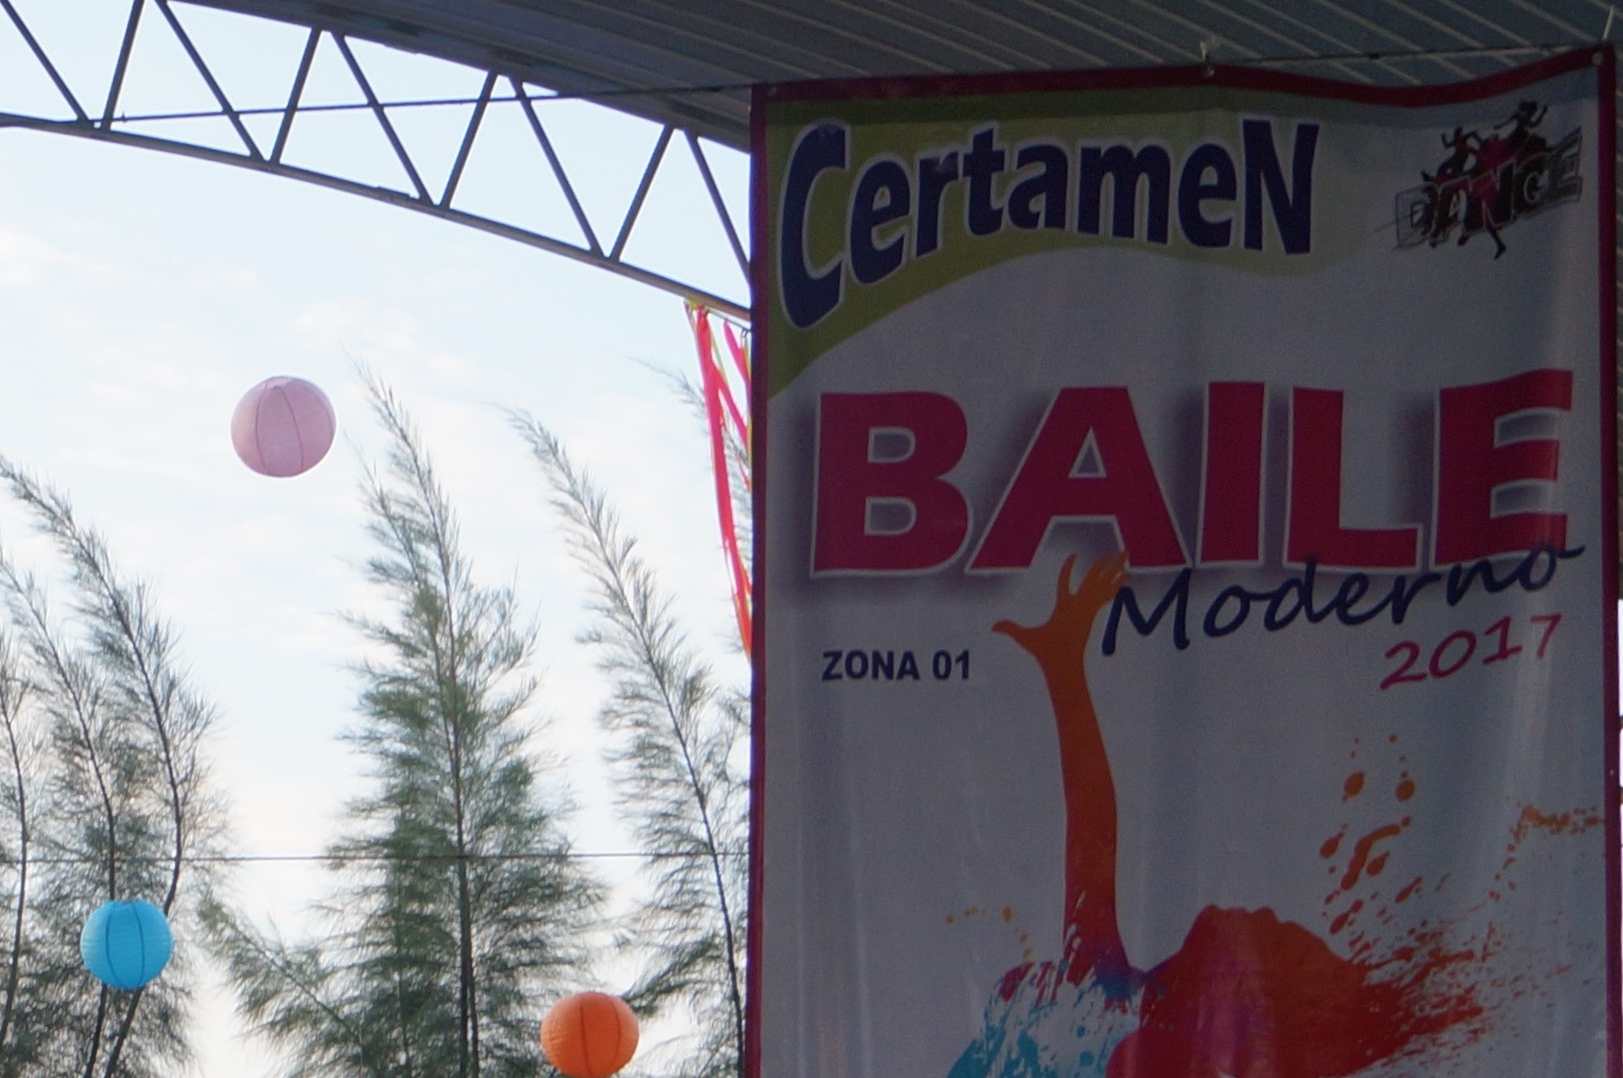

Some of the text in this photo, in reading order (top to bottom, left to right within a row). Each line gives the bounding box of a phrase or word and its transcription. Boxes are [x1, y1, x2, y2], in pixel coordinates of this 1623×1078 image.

[781, 119, 1319, 327] CertameN
[812, 369, 1574, 575] BAILE
[1102, 543, 1585, 655] Moderno
[1380, 613, 1562, 689] 2017
[821, 648, 972, 682] ZONA 01
